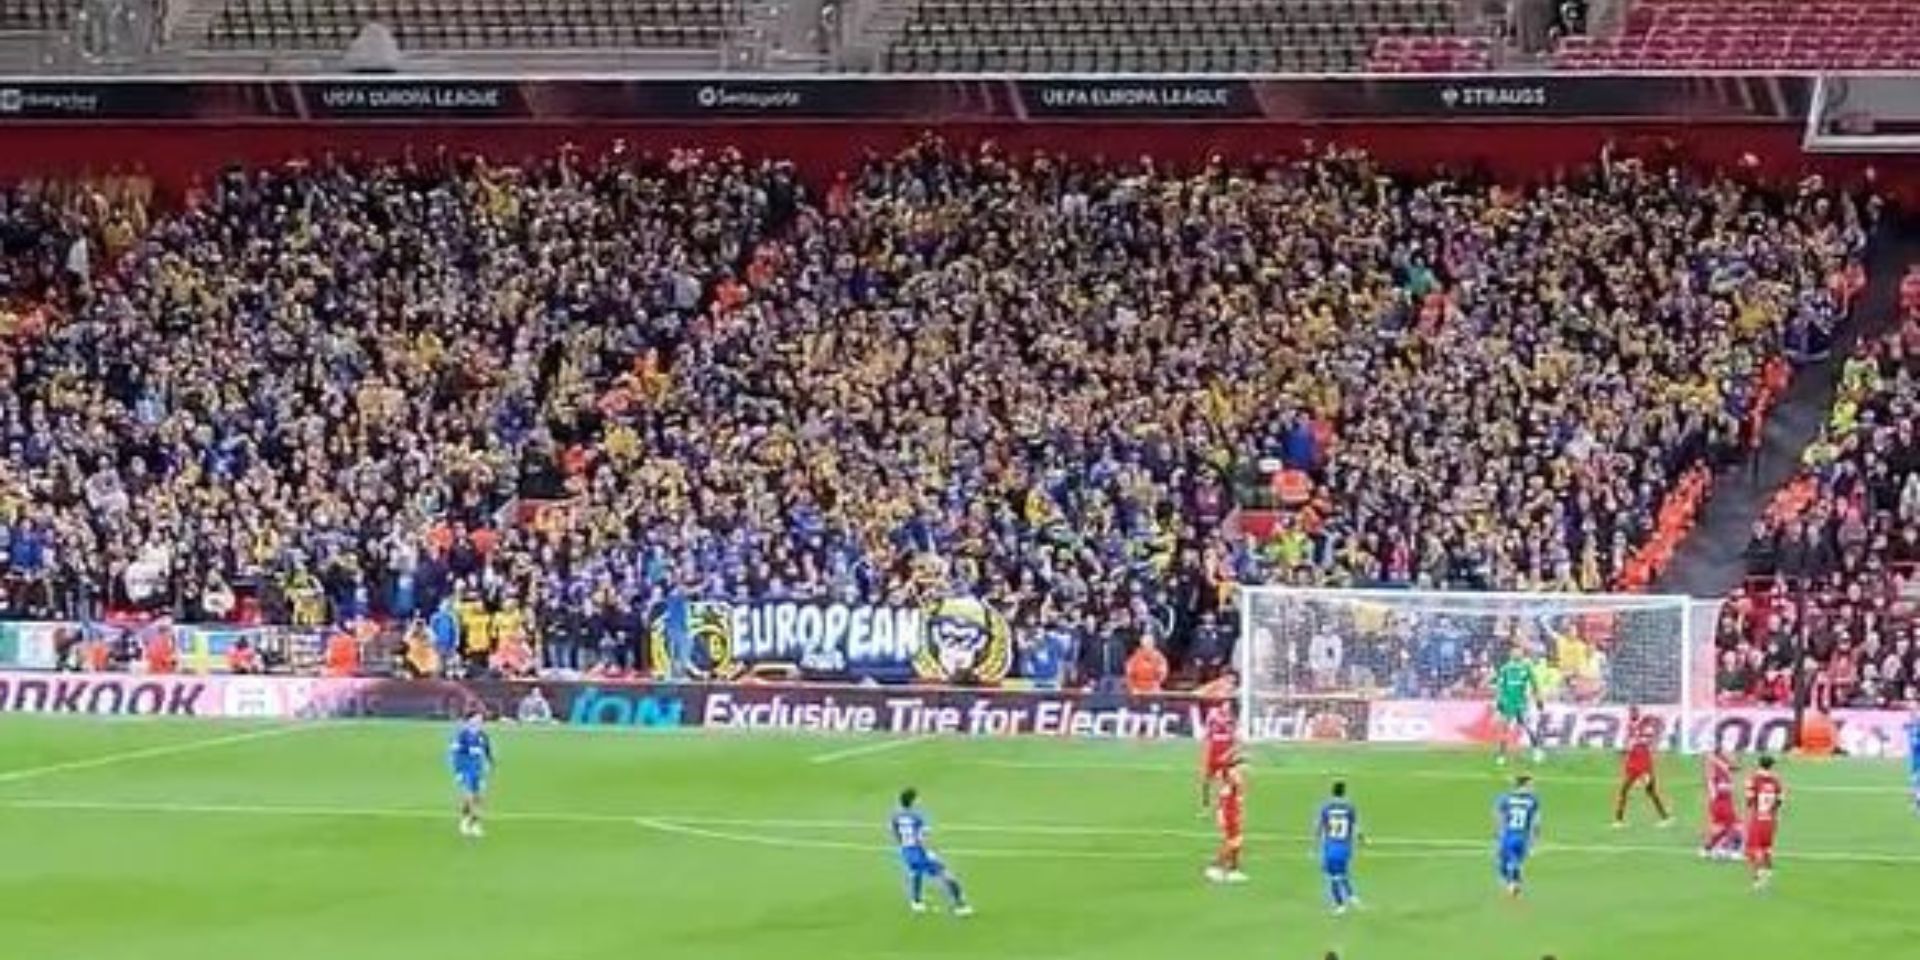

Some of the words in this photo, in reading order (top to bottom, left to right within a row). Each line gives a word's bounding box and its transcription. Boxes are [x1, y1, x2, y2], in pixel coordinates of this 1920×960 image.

[1462, 88, 1546, 105] STRAUSS
[730, 602, 921, 659] EUROPEAN
[704, 693, 877, 731] Exclusive
[886, 697, 964, 733] Tire
[967, 698, 1027, 735] for
[1034, 701, 1180, 740] Electric
